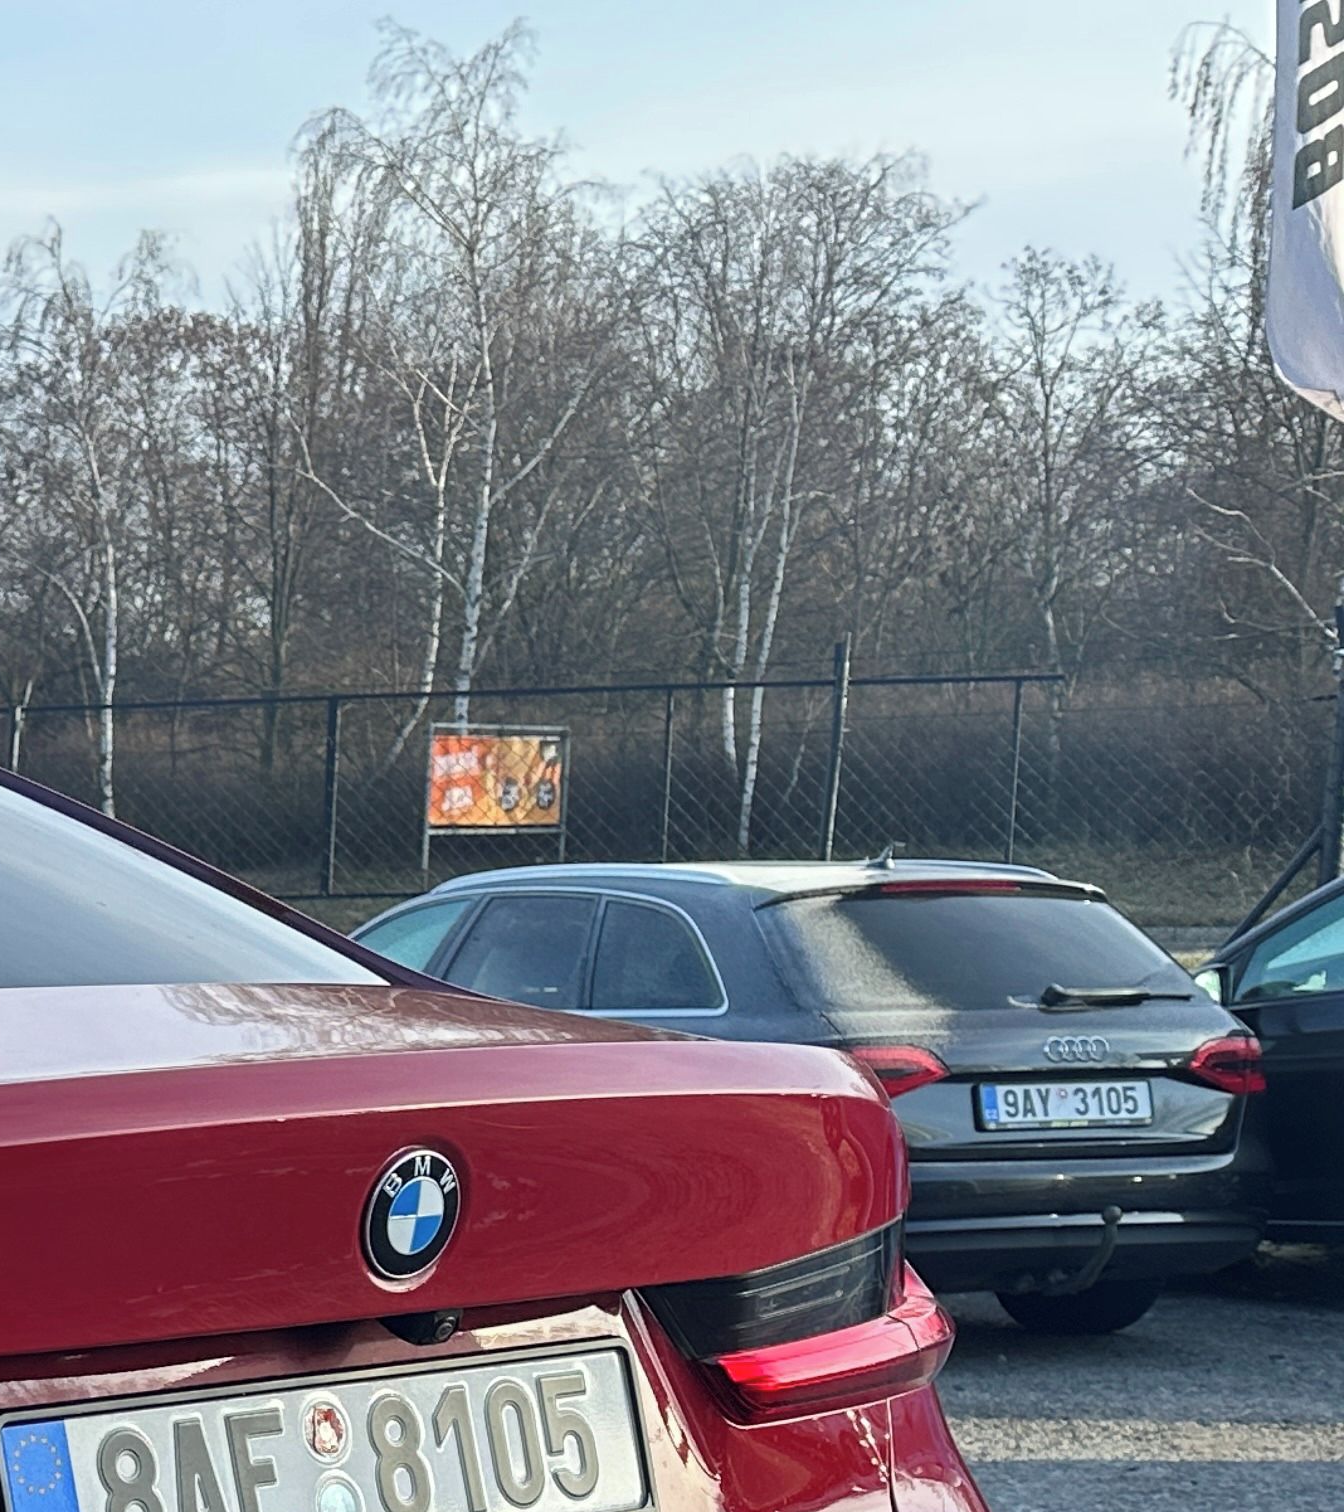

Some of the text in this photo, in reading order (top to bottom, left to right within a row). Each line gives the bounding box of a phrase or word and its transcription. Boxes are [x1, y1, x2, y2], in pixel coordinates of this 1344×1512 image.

[1003, 1085, 1139, 1118] 9AY 3105
[383, 1155, 456, 1198] BMW
